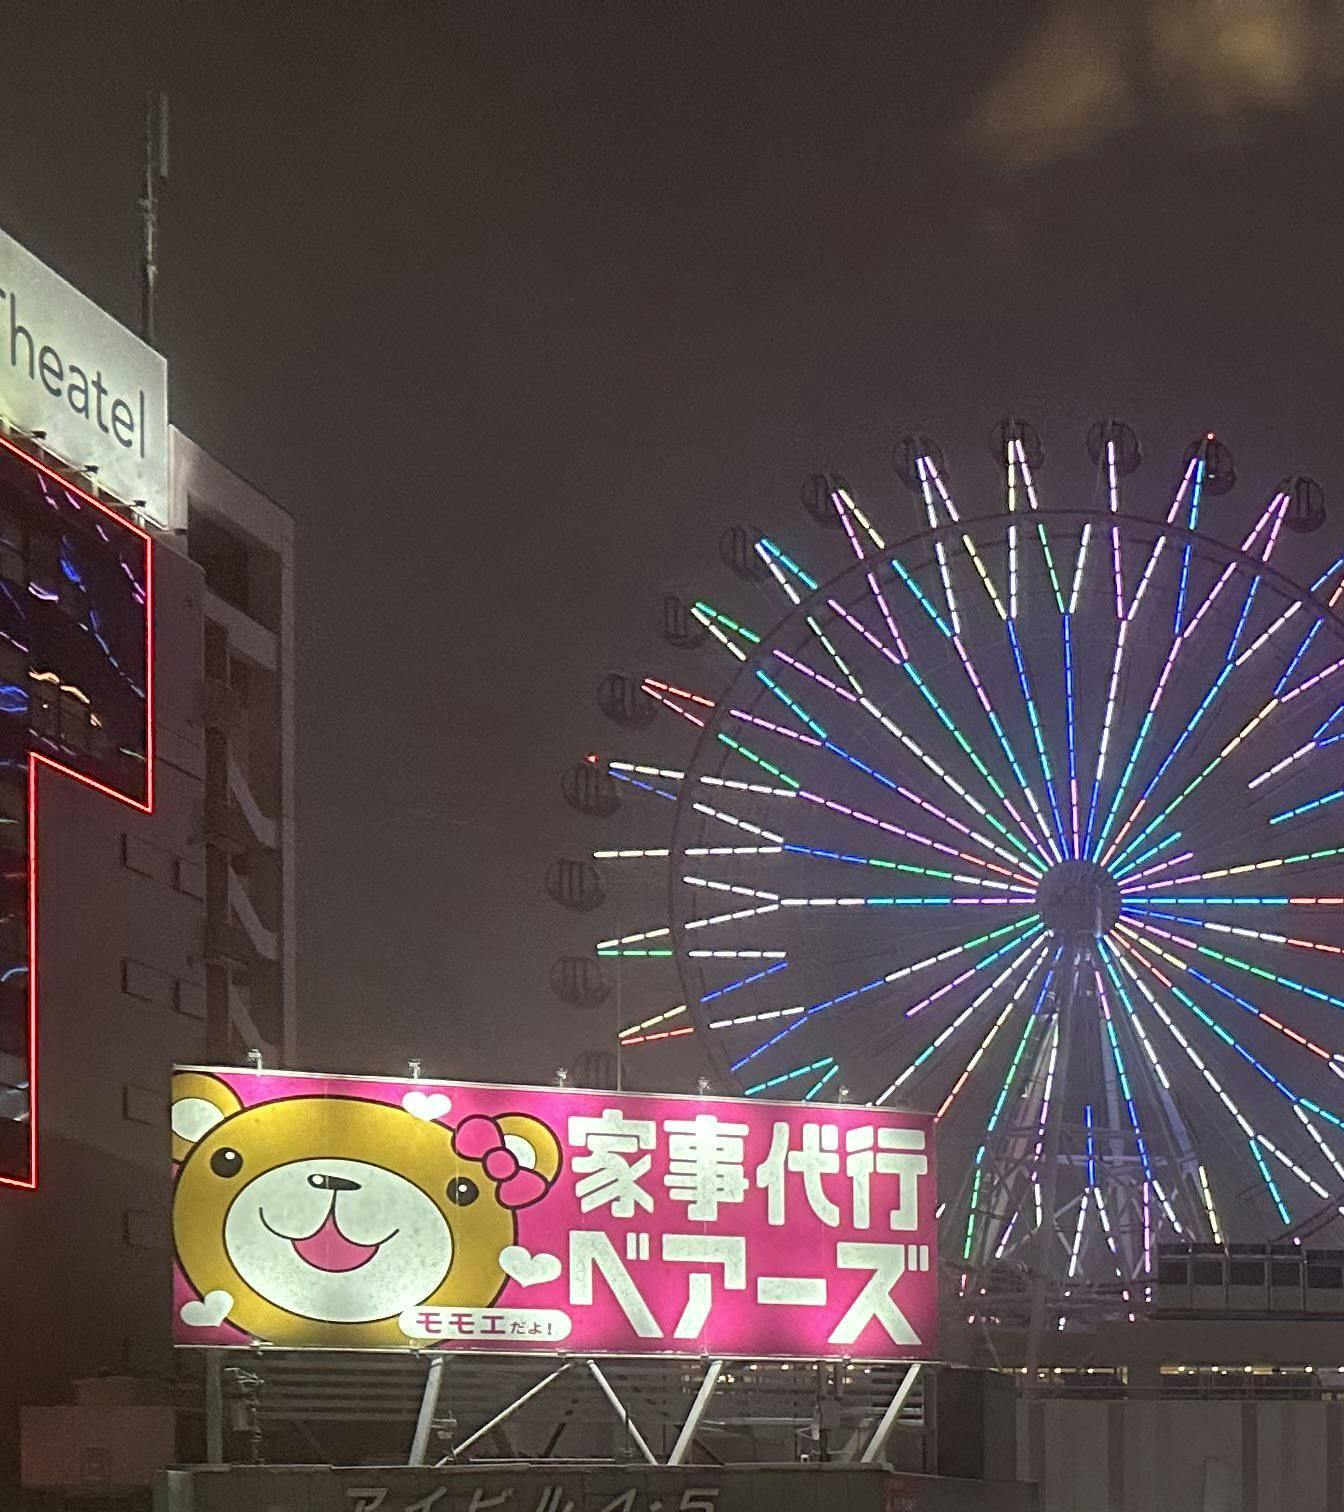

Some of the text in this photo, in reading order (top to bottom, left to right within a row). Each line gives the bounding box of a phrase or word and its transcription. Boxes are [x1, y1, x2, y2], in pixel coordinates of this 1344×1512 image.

[0, 290, 145, 459] heatel
[568, 1108, 928, 1231] 家事代行
[570, 1231, 929, 1346] ベアーズ
